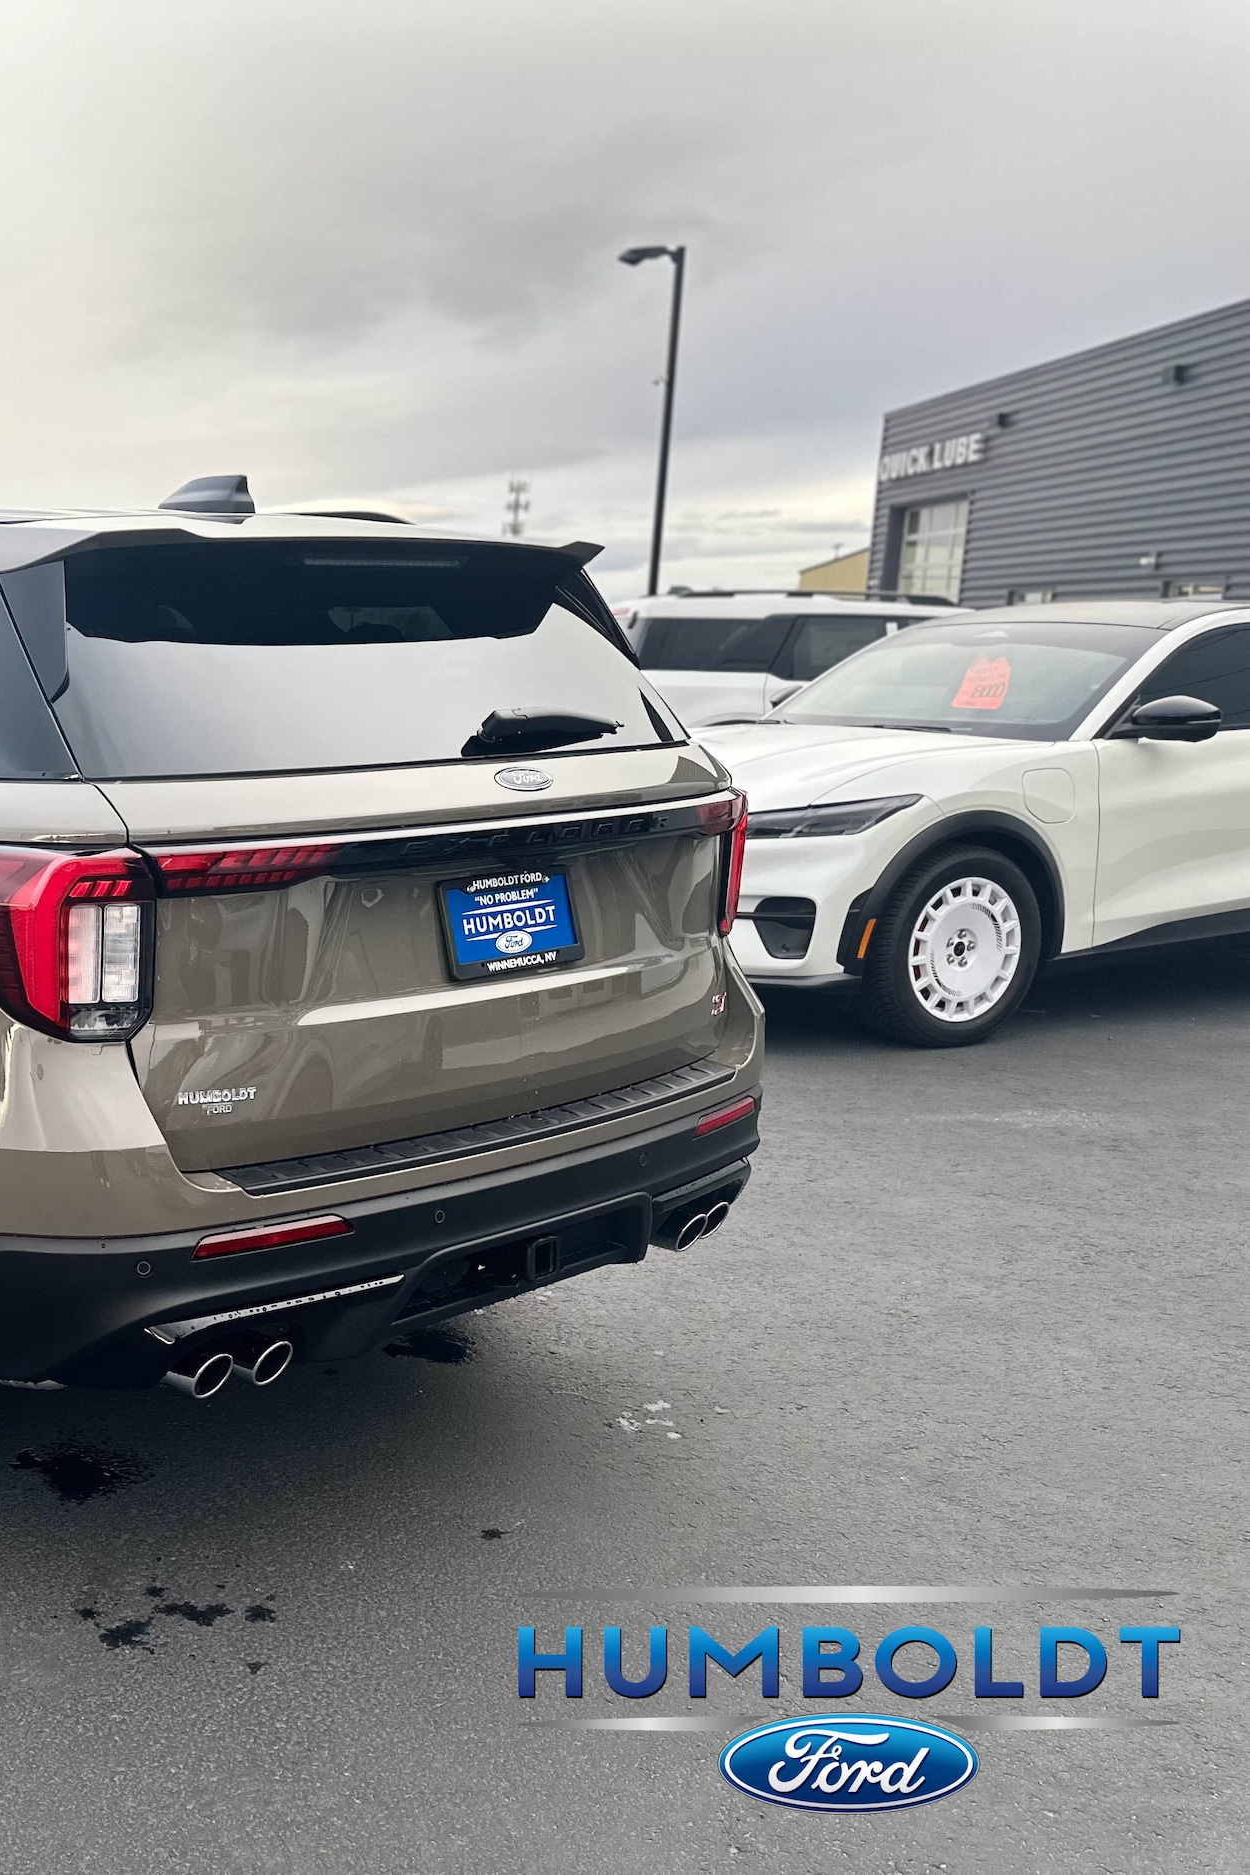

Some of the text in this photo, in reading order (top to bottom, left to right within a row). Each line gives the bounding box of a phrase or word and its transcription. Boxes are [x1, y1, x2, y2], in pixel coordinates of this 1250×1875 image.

[879, 433, 985, 481] QUICK LUBE
[512, 770, 543, 784] Ford
[473, 872, 542, 890] HUMBOLDT FORD
[463, 905, 556, 935] HUMBOLDT
[504, 934, 524, 949] Ford
[487, 950, 557, 972] WINNEMUCCA, NV
[177, 1086, 257, 1105] HUMBOLDT
[206, 1104, 233, 1115] FORD
